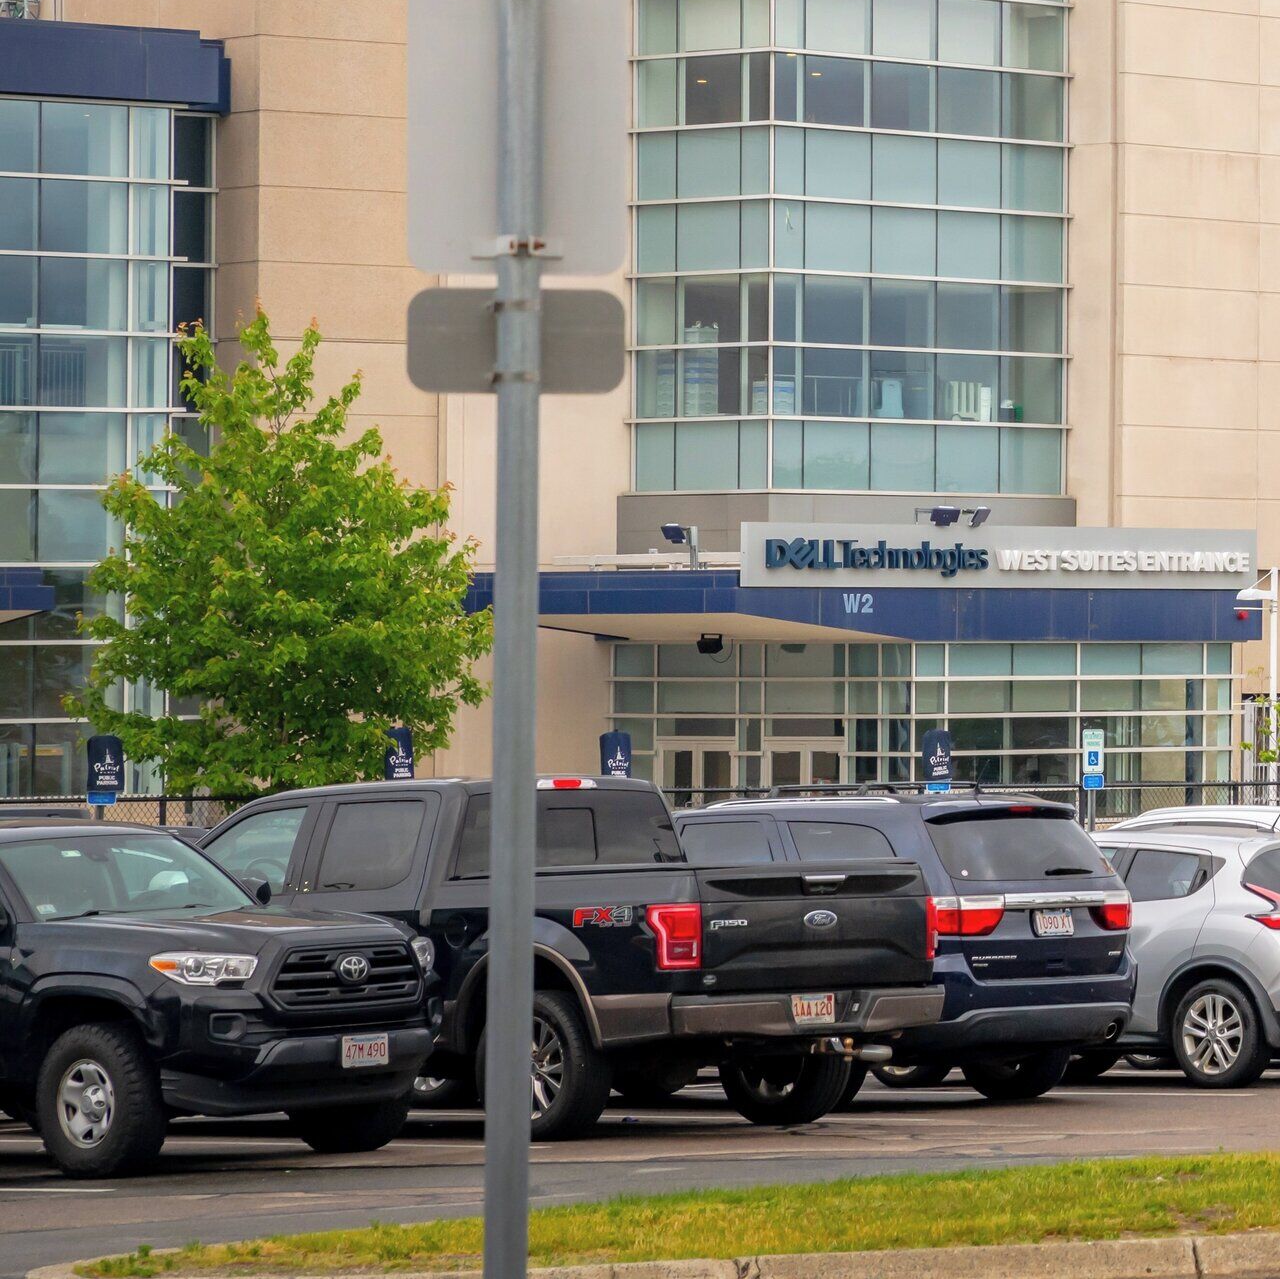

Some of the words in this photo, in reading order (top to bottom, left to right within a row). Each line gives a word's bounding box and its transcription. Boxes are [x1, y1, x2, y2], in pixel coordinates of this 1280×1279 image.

[765, 538, 842, 569] DELL
[837, 538, 989, 577] Technologies
[997, 548, 1060, 571] WEST
[1061, 549, 1138, 572] SUITES
[1139, 550, 1250, 573] ENTRANCE
[843, 593, 874, 614] W2
[573, 905, 632, 928] FX4
[794, 1002, 812, 1017] 1AA
[814, 1001, 833, 1016] 120
[367, 1041, 386, 1058] 490
